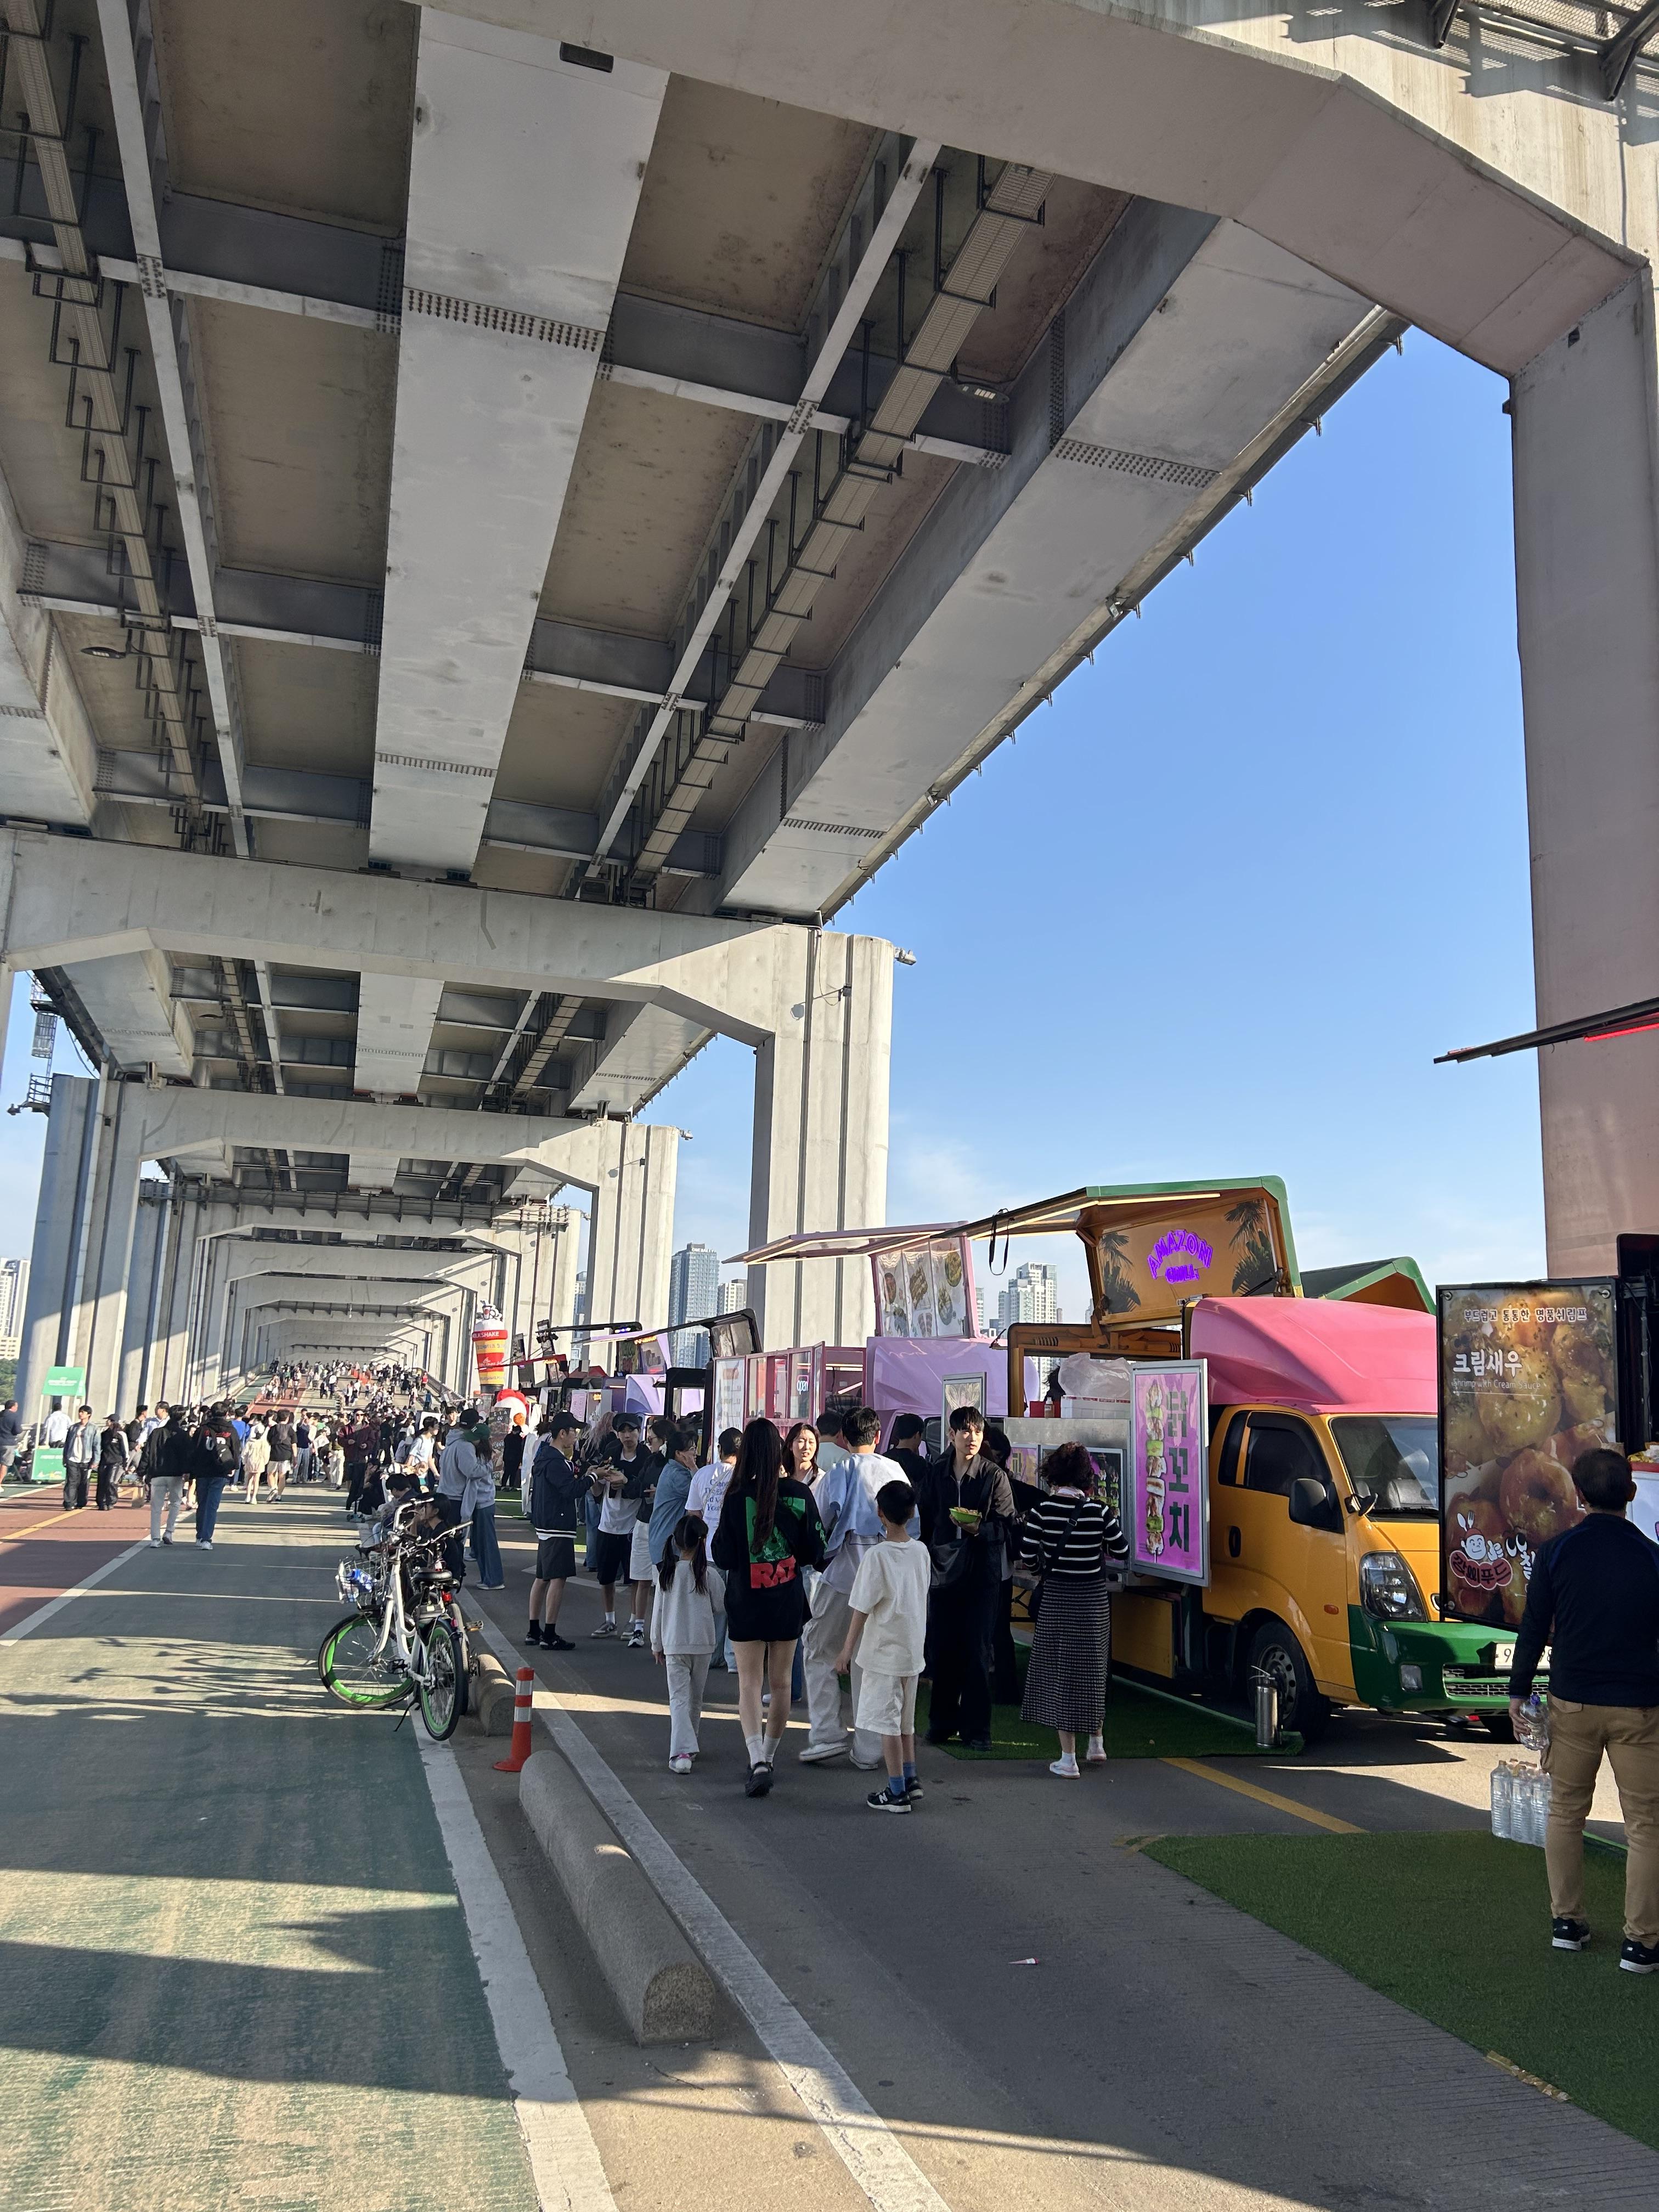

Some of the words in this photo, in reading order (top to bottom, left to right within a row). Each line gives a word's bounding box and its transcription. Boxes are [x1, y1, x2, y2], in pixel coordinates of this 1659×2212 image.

[1147, 1229, 1213, 1279] AMAZON
[1464, 1309, 1498, 1322] 부드럽고
[1502, 1308, 1530, 1322] 통통한
[1535, 1307, 1588, 1322] 명품쉬림프
[1453, 1349, 1522, 1378] 크림새우
[1453, 1378, 1475, 1389] Shrimp
[1477, 1378, 1492, 1387] with
[1493, 1379, 1516, 1389] Cream
[1518, 1381, 1541, 1390] Sauce
